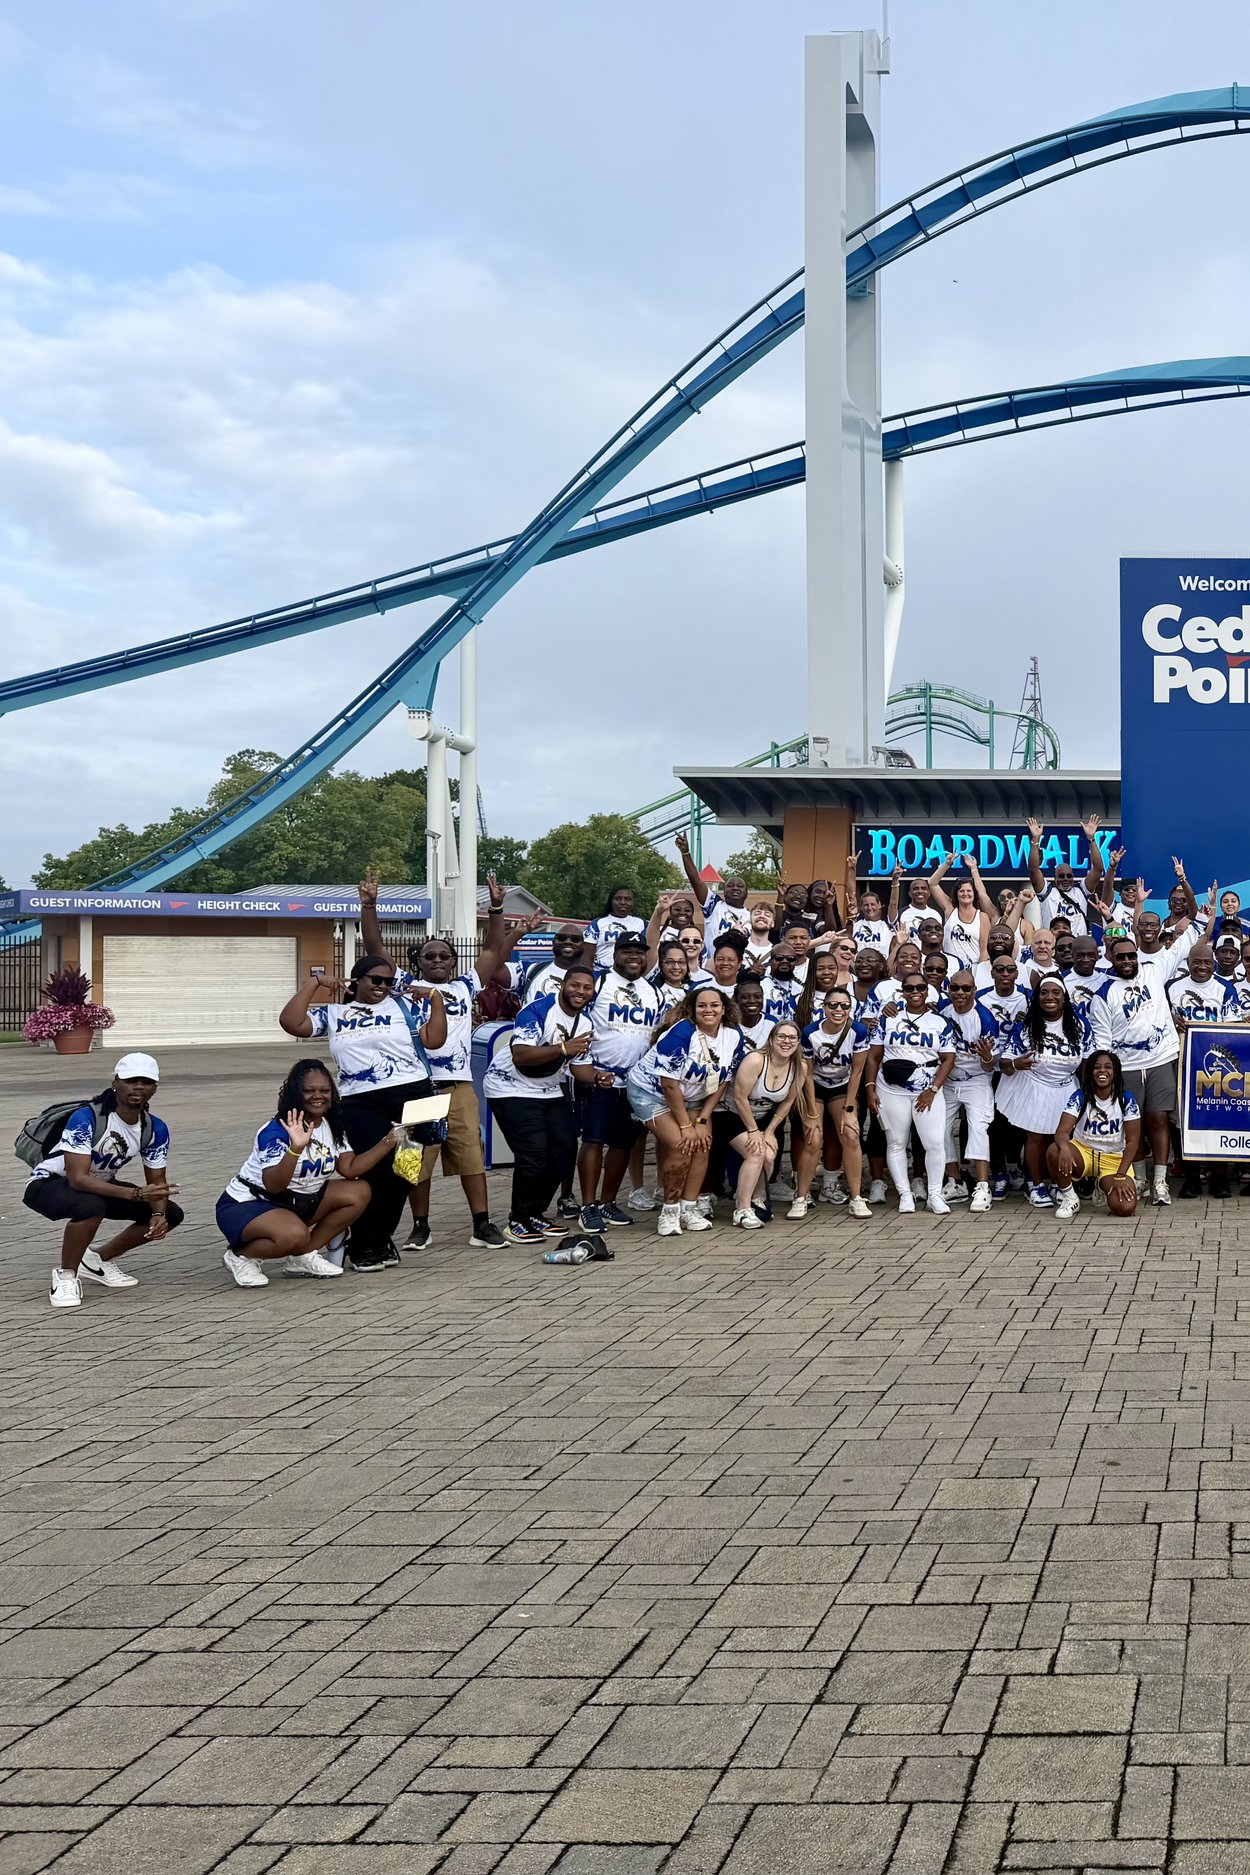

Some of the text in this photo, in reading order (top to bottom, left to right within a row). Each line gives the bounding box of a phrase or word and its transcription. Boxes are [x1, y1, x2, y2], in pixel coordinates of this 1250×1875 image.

[30, 898, 161, 909] GUEST INFORMATION
[197, 901, 281, 911] HEIGHT CHECK
[313, 903, 422, 913] GUEST INRMATION
[607, 1003, 657, 1027] MCN
[1176, 1005, 1218, 1022] MCN
[335, 1014, 392, 1034] MCN
[889, 1030, 934, 1048] MCN
[1197, 1097, 1228, 1105] Melanin
[1084, 1118, 1120, 1135] MCN
[300, 1156, 338, 1179] MC
